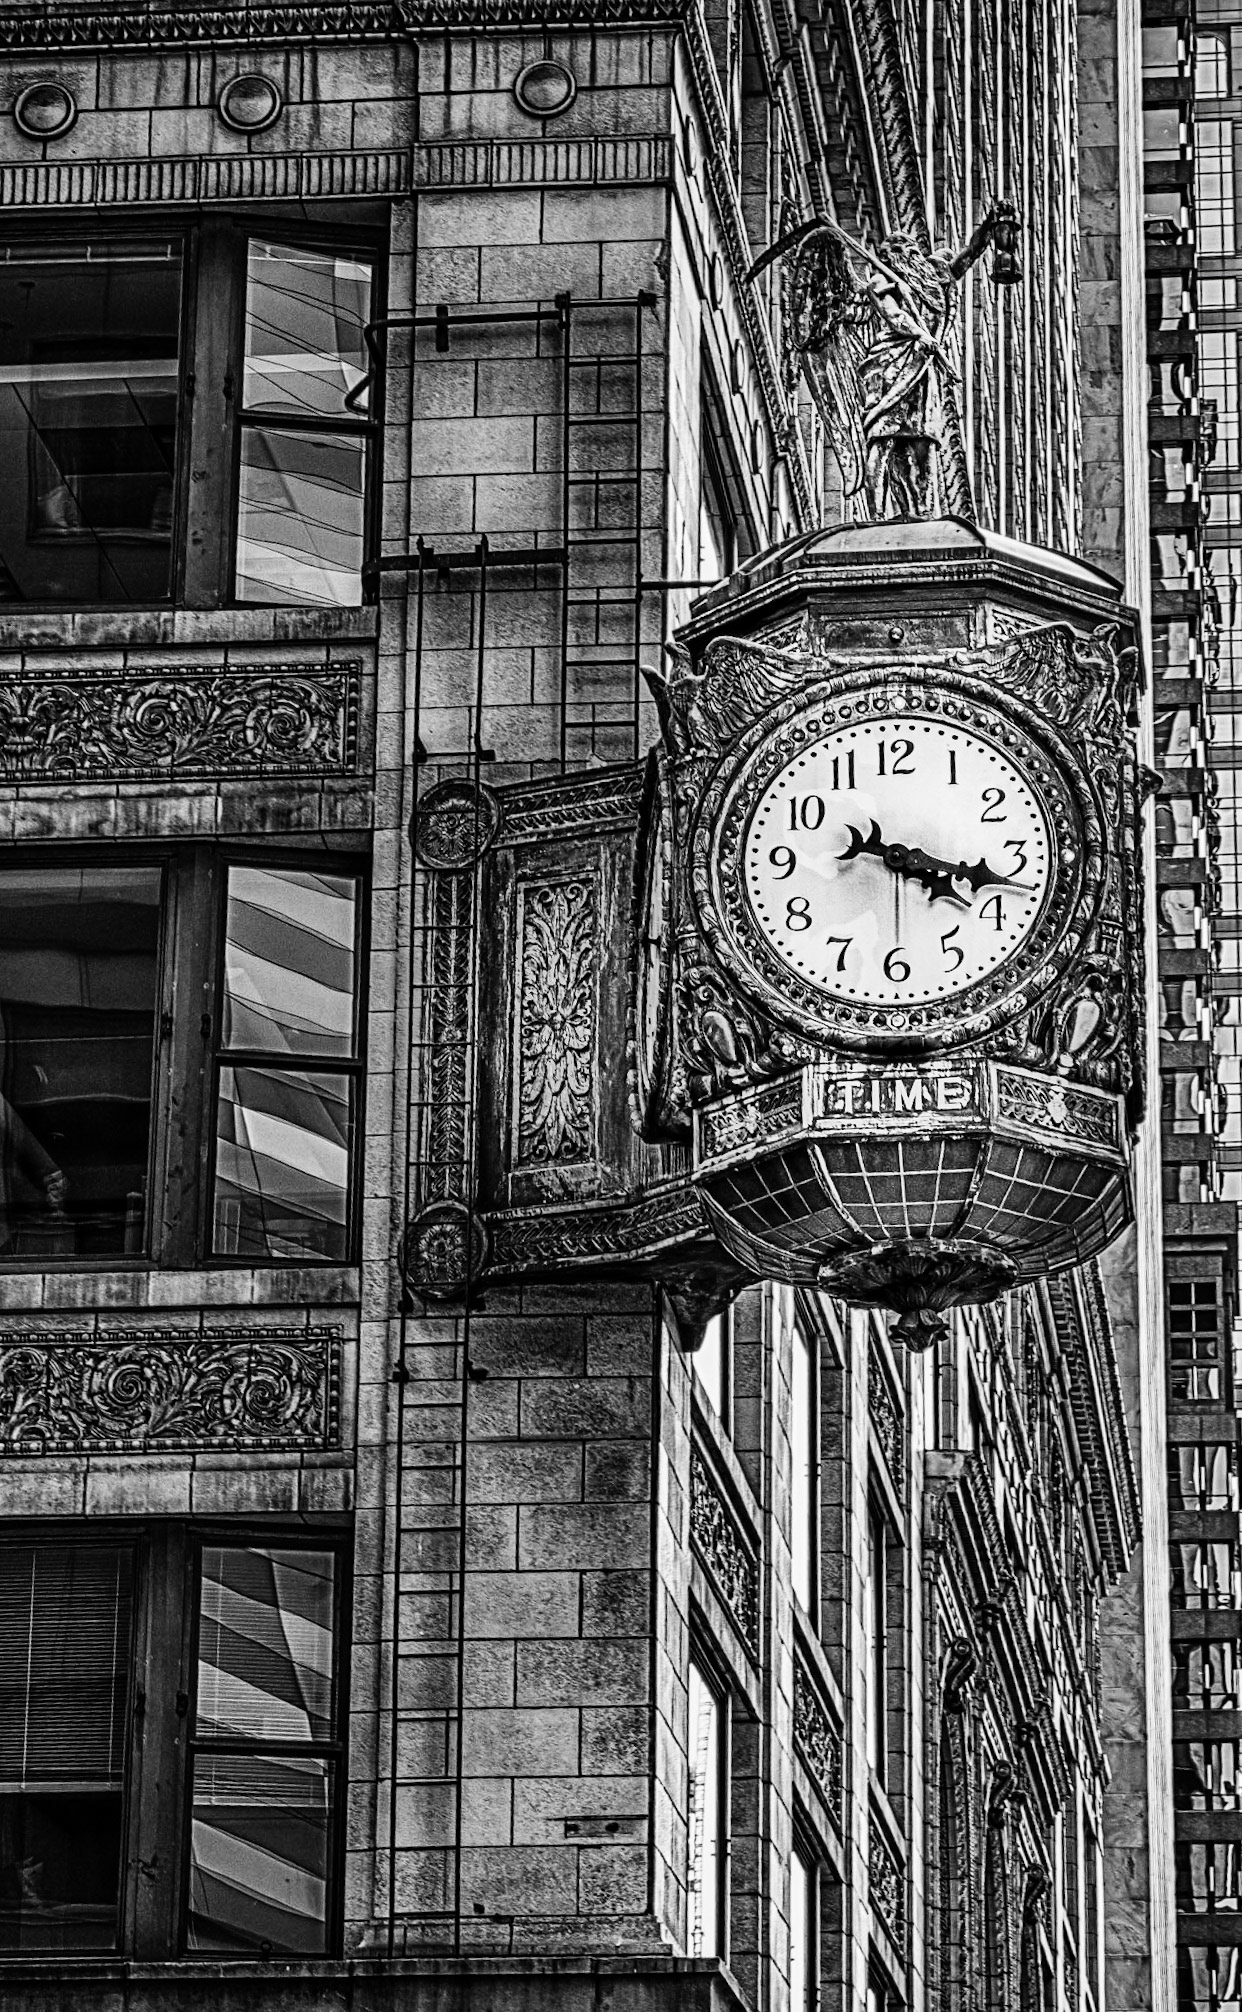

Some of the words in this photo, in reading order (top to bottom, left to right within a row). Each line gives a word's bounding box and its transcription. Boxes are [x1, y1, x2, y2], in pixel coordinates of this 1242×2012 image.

[831, 749, 858, 790] 11
[877, 739, 915, 776] 12
[947, 750, 959, 785] 1
[787, 795, 825, 831] 10
[980, 787, 1008, 823] 2
[769, 845, 797, 880] 9
[1003, 840, 1027, 878] 3
[785, 896, 812, 931] 8
[979, 895, 1007, 931] 4
[826, 936, 854, 972] 7
[883, 947, 911, 982] 6
[940, 925, 964, 973] 5
[836, 1077, 965, 1114] TIME
